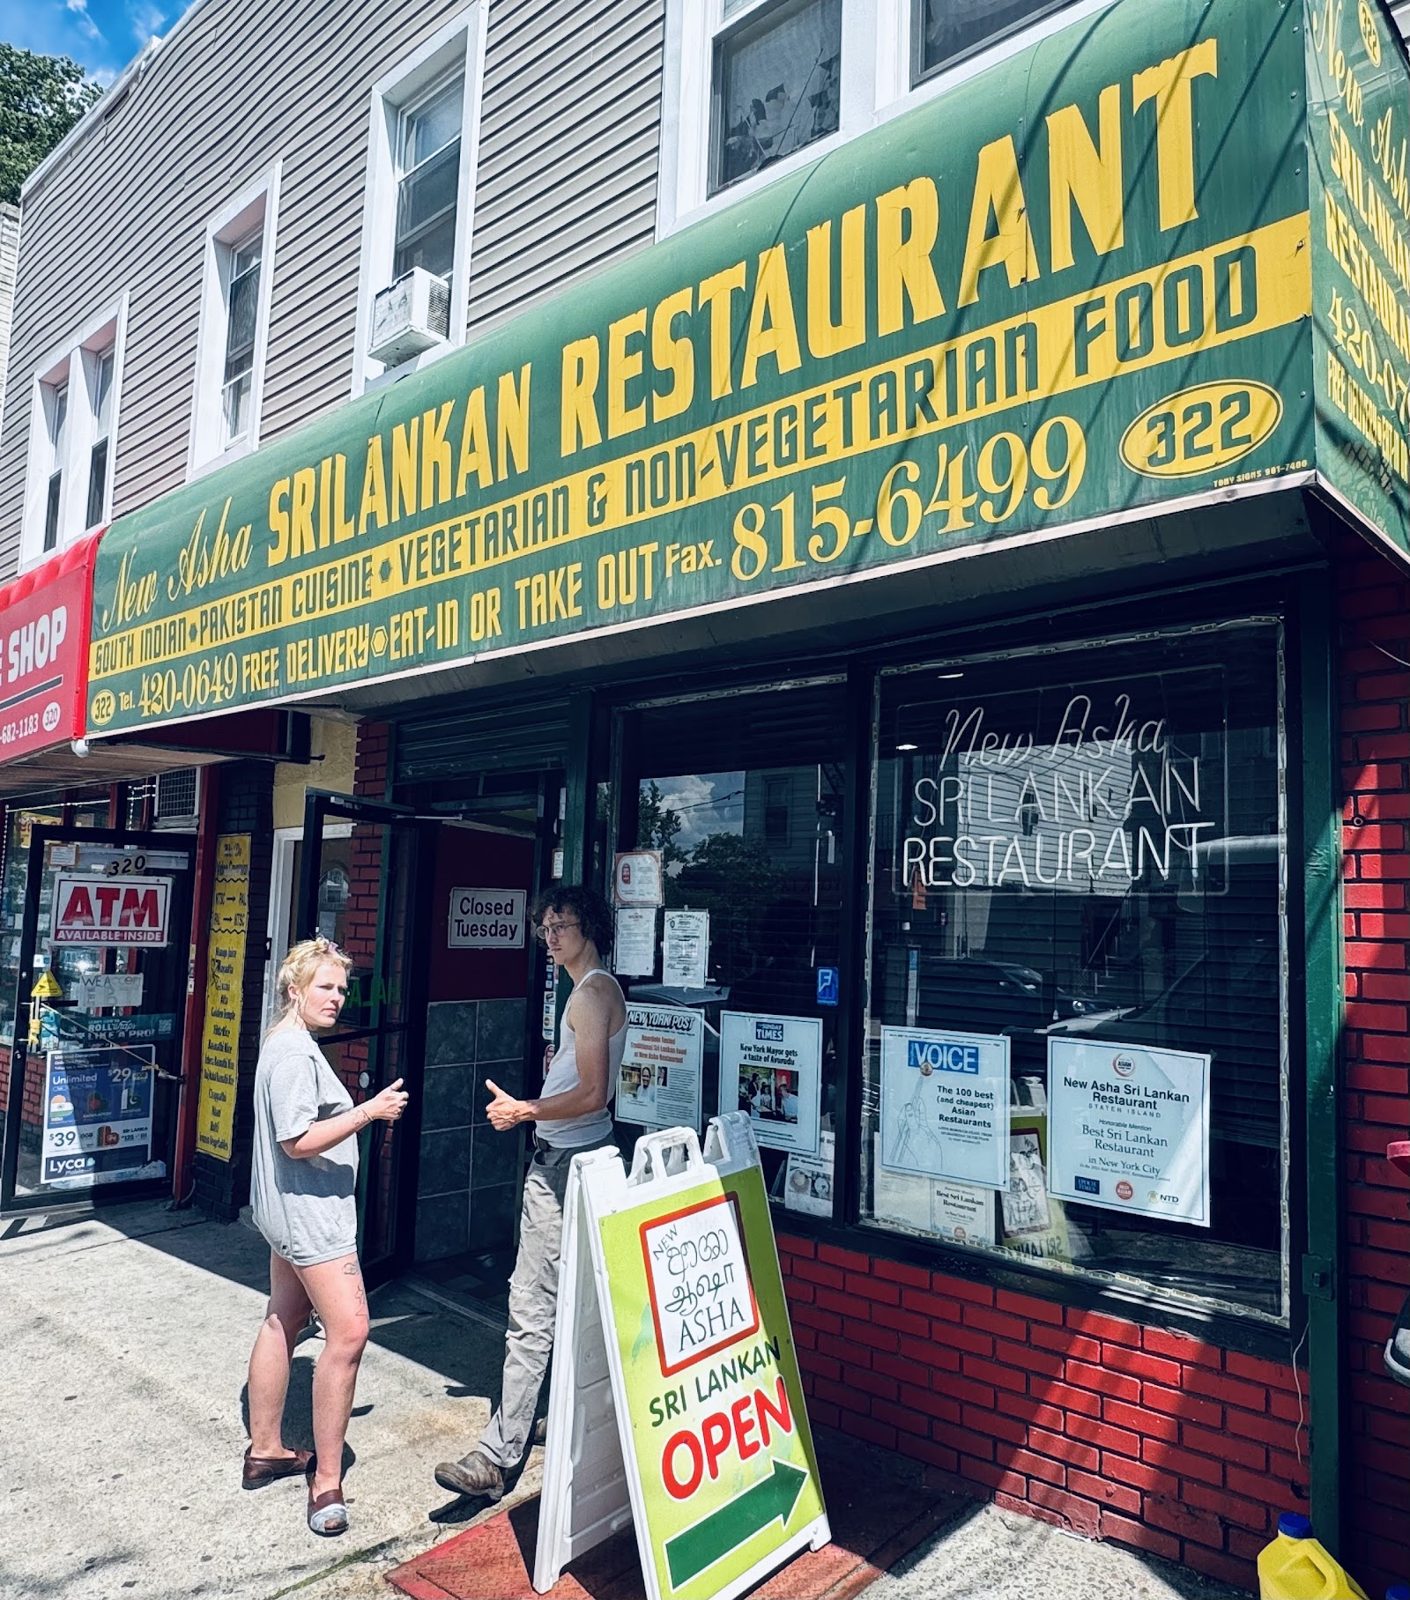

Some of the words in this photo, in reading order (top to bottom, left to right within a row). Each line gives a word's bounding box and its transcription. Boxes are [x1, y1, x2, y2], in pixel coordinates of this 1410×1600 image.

[1370, 106, 1410, 221] Ash
[561, 37, 1218, 458] RESTAURANT
[1325, 186, 1410, 364] RESTAURA
[1147, 390, 1252, 468] 322
[94, 637, 135, 675] SOUTH
[139, 622, 187, 663] INDIAN
[199, 584, 283, 642] PAKISTAN
[291, 555, 373, 619] CUISINE
[399, 483, 569, 586] VEGETARIAN
[587, 472, 608, 527] &
[1073, 245, 1258, 378] FOOD
[102, 546, 159, 631] New
[168, 495, 253, 600] Asha
[118, 688, 136, 712] Tel.
[138, 651, 238, 718] 420-0649
[241, 647, 280, 696] FREE
[286, 622, 369, 685] DELIVERY
[389, 598, 459, 661] EAT-IN
[470, 587, 502, 644] OR
[515, 562, 584, 631] TAKE
[597, 541, 659, 611] OUT
[731, 415, 1088, 582] 815-6499
[8, 605, 68, 684] SHOP
[44, 705, 59, 727] 320
[94, 695, 111, 721] 322
[940, 706, 1034, 770] New
[1044, 694, 1166, 760] Asha
[108, 854, 146, 876] 320
[903, 821, 1216, 888] RESTAURANT
[59, 886, 160, 928] ATM
[459, 897, 514, 917] Closed
[57, 928, 121, 942] AVAILABLE
[123, 930, 162, 942] INSIDE
[454, 918, 518, 942] Tuesday
[88, 1023, 112, 1032] ROLL
[628, 1010, 648, 1026] NEW
[647, 1011, 673, 1030] YORK
[671, 1015, 697, 1031] POST
[756, 1029, 783, 1040] TIMES
[740, 1043, 752, 1051] New
[753, 1044, 765, 1053] York
[766, 1046, 784, 1056] Mayor
[784, 1050, 798, 1058] gets
[748, 1053, 762, 1061] taste
[914, 1043, 977, 1073] VOICE
[52, 1072, 98, 1085] Unlimited
[107, 1067, 131, 1083] $29
[937, 1085, 953, 1095] The
[956, 1087, 972, 1097] 100
[974, 1090, 994, 1100] best
[1063, 1076, 1088, 1089] New
[1091, 1080, 1120, 1093] Asha
[1124, 1085, 1140, 1096] Sri
[1144, 1087, 1190, 1103] Lankan
[1092, 1091, 1158, 1110] Restaurant
[936, 1095, 954, 1104] (and
[955, 1098, 994, 1111] cheapest)
[952, 1106, 976, 1117] Asian
[1088, 1103, 1122, 1113] STATEN
[1127, 1109, 1162, 1119] ISLAND
[939, 1114, 992, 1129] Restaurants
[1099, 1119, 1127, 1129] Honorable
[1128, 1123, 1152, 1132] Mention
[49, 1131, 76, 1147] $39
[1082, 1124, 1104, 1138] Best
[1107, 1128, 1122, 1140] Sri
[1125, 1131, 1168, 1147] Lankan
[1095, 1138, 1155, 1158] Restaurant
[49, 1158, 85, 1173] Lyca
[1098, 1157, 1119, 1167] New
[1120, 1160, 1140, 1171] York
[1142, 1164, 1160, 1178] City
[1160, 1194, 1179, 1203] NTD
[653, 1224, 679, 1261] NEW
[679, 1297, 746, 1353] ASHA
[649, 1384, 687, 1428] SRI
[697, 1335, 781, 1404] LANKAN
[661, 1375, 792, 1500] OPEN
